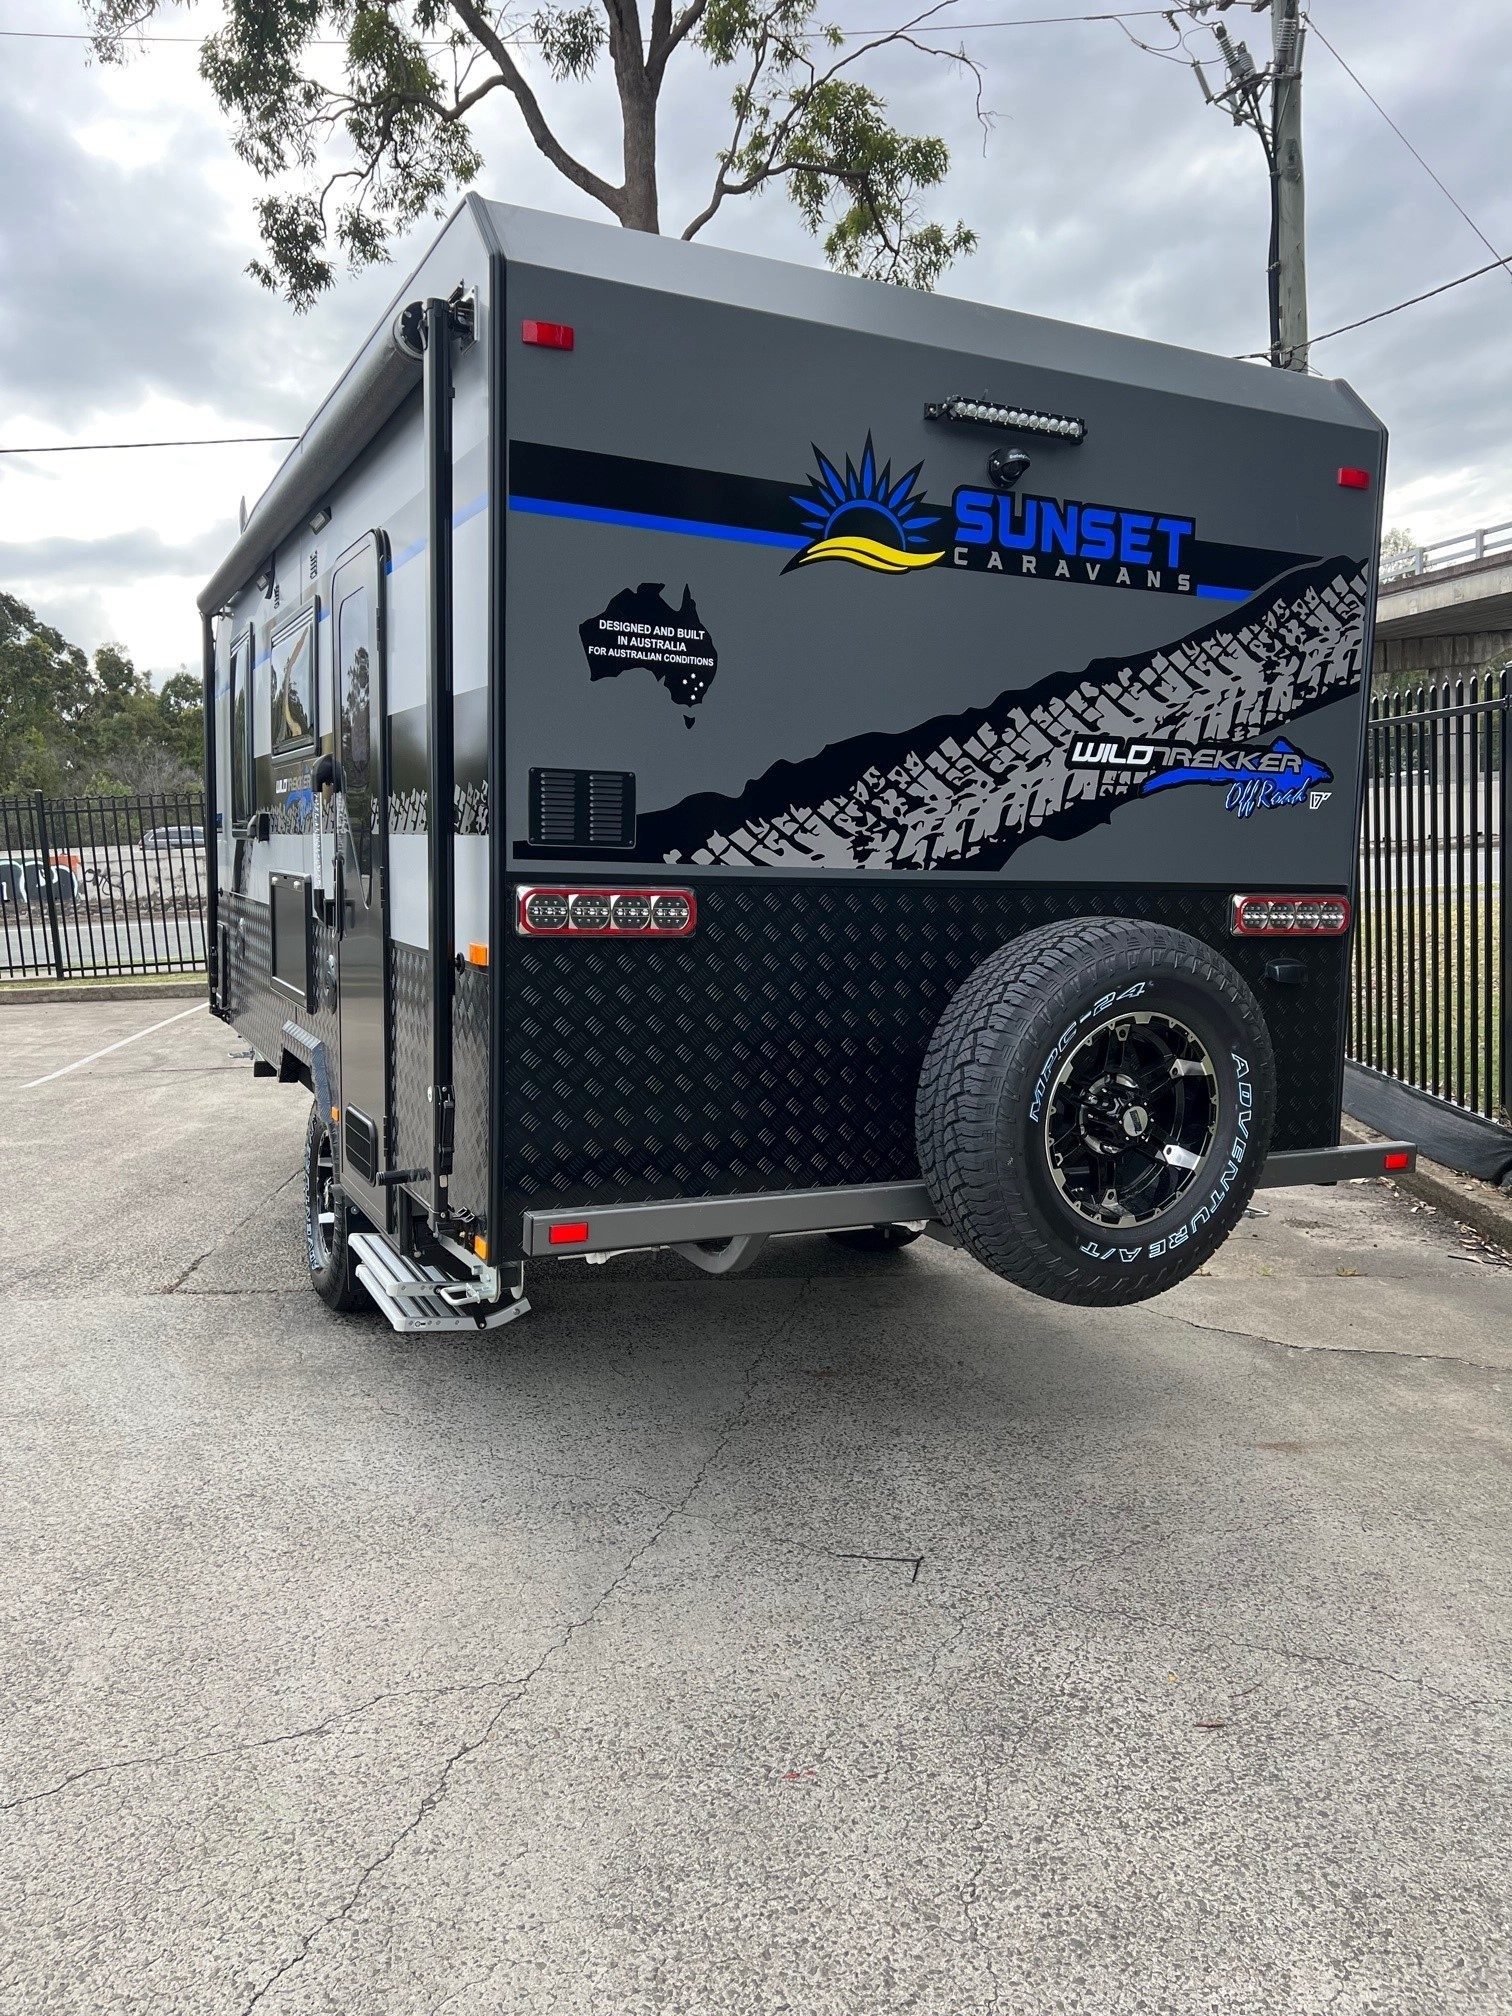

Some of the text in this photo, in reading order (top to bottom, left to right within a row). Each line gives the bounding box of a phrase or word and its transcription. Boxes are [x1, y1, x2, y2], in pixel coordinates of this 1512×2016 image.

[955, 490, 1192, 568] SUNSET
[953, 546, 1191, 591] CARAVANS
[599, 619, 705, 640] DESIGNED AND BUILT
[617, 635, 687, 652] IN AUSTRALIA
[588, 645, 714, 667] FOR AUSTRALIAN CONDITIONS
[1029, 981, 1146, 1123] MPC-24
[1080, 1052, 1252, 1263] ADVENTURE A/T
